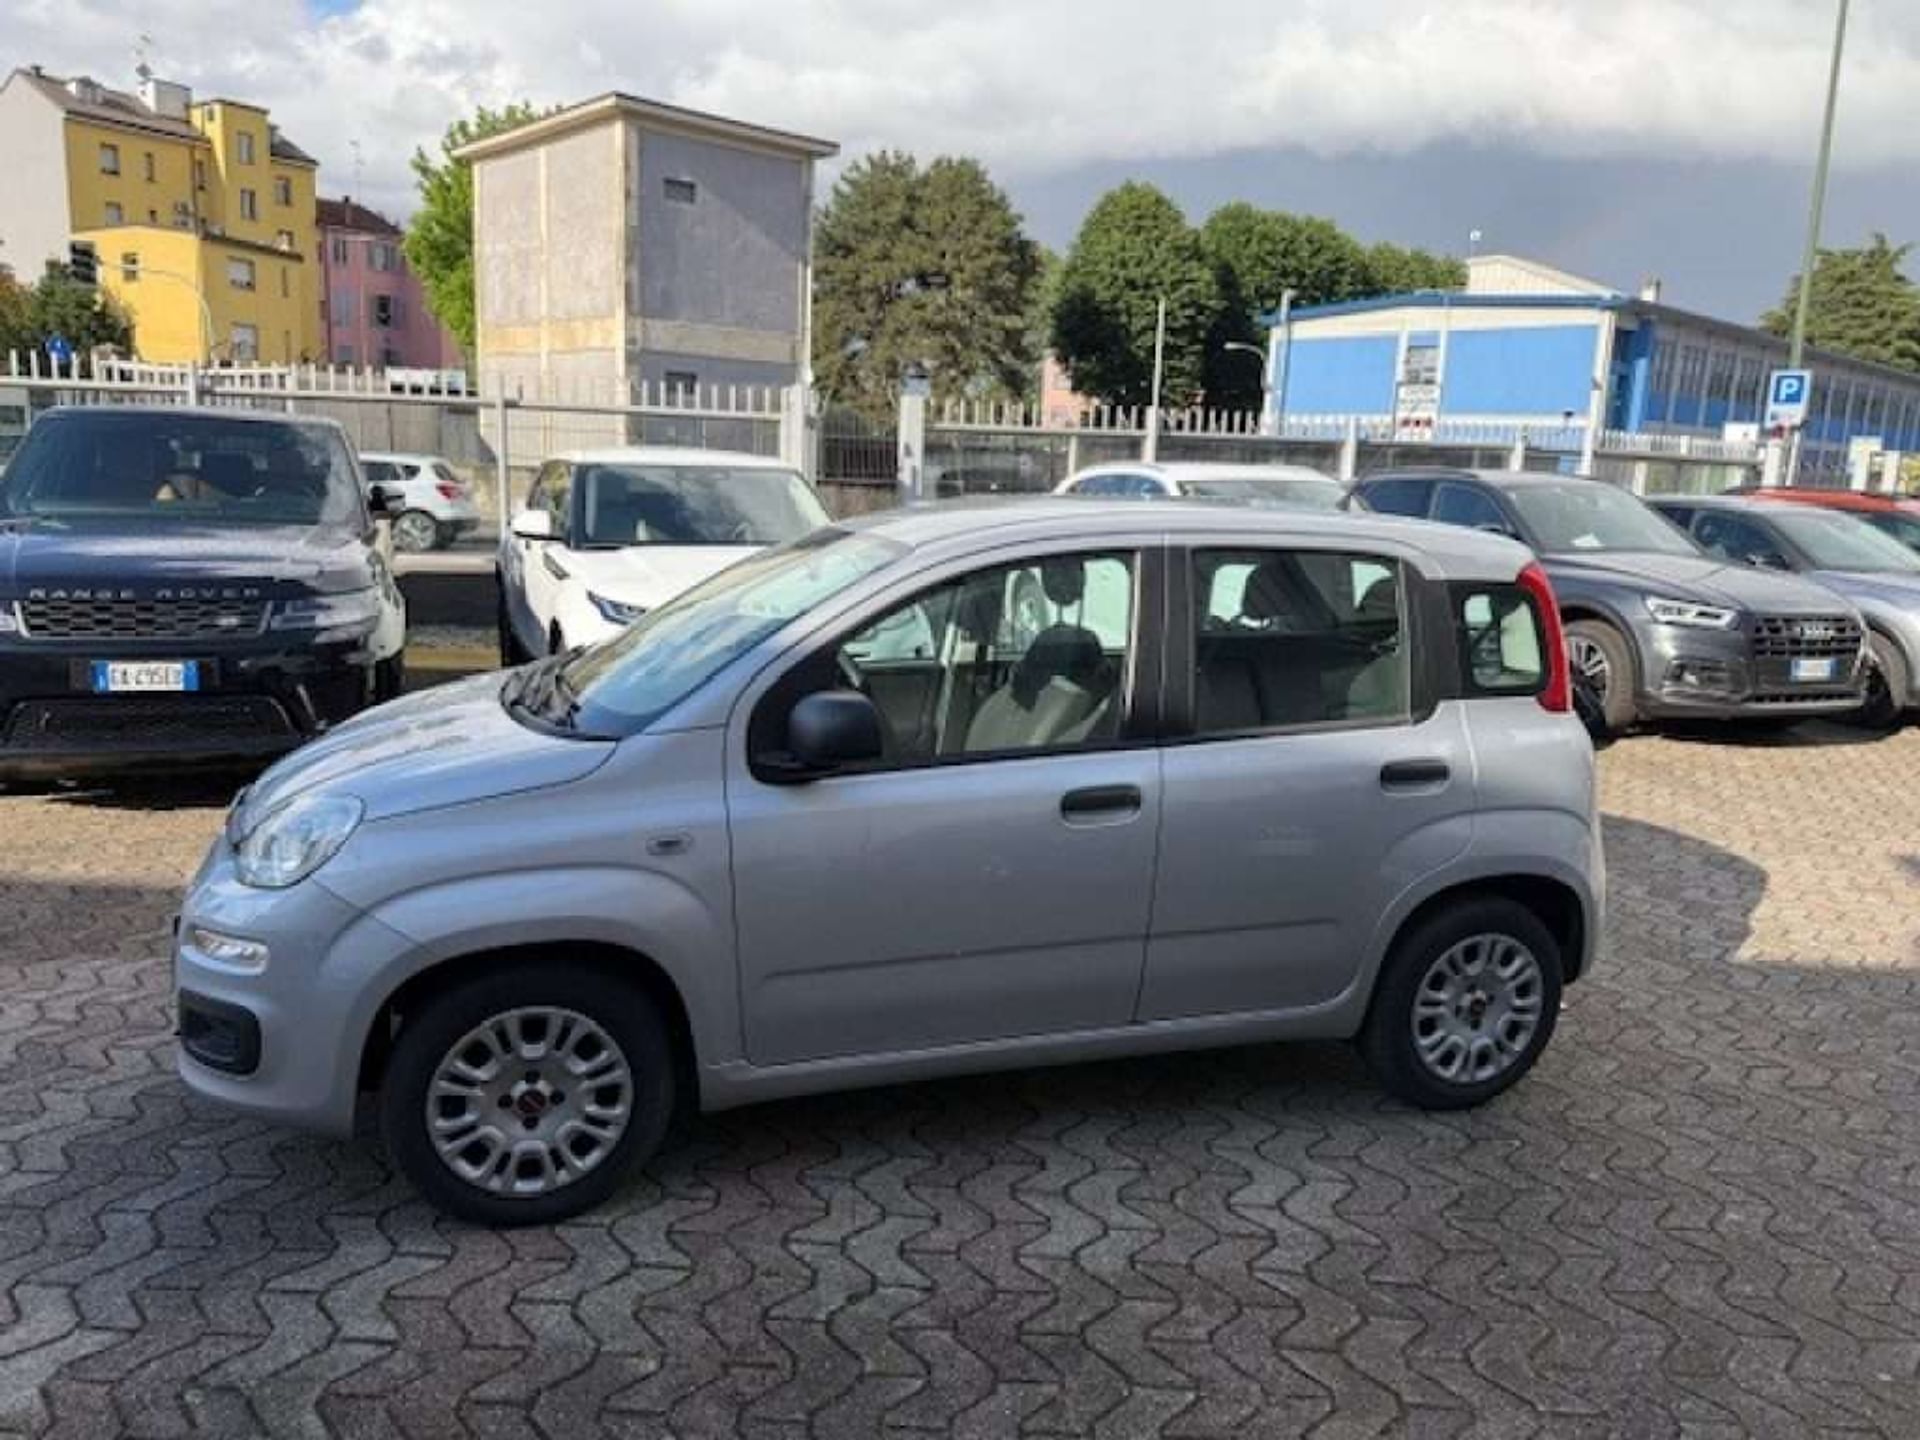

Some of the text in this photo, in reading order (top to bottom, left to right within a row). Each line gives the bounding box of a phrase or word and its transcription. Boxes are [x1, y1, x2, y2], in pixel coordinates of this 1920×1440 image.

[1780, 378, 1799, 401] P
[30, 587, 260, 600] RANGE ROVER
